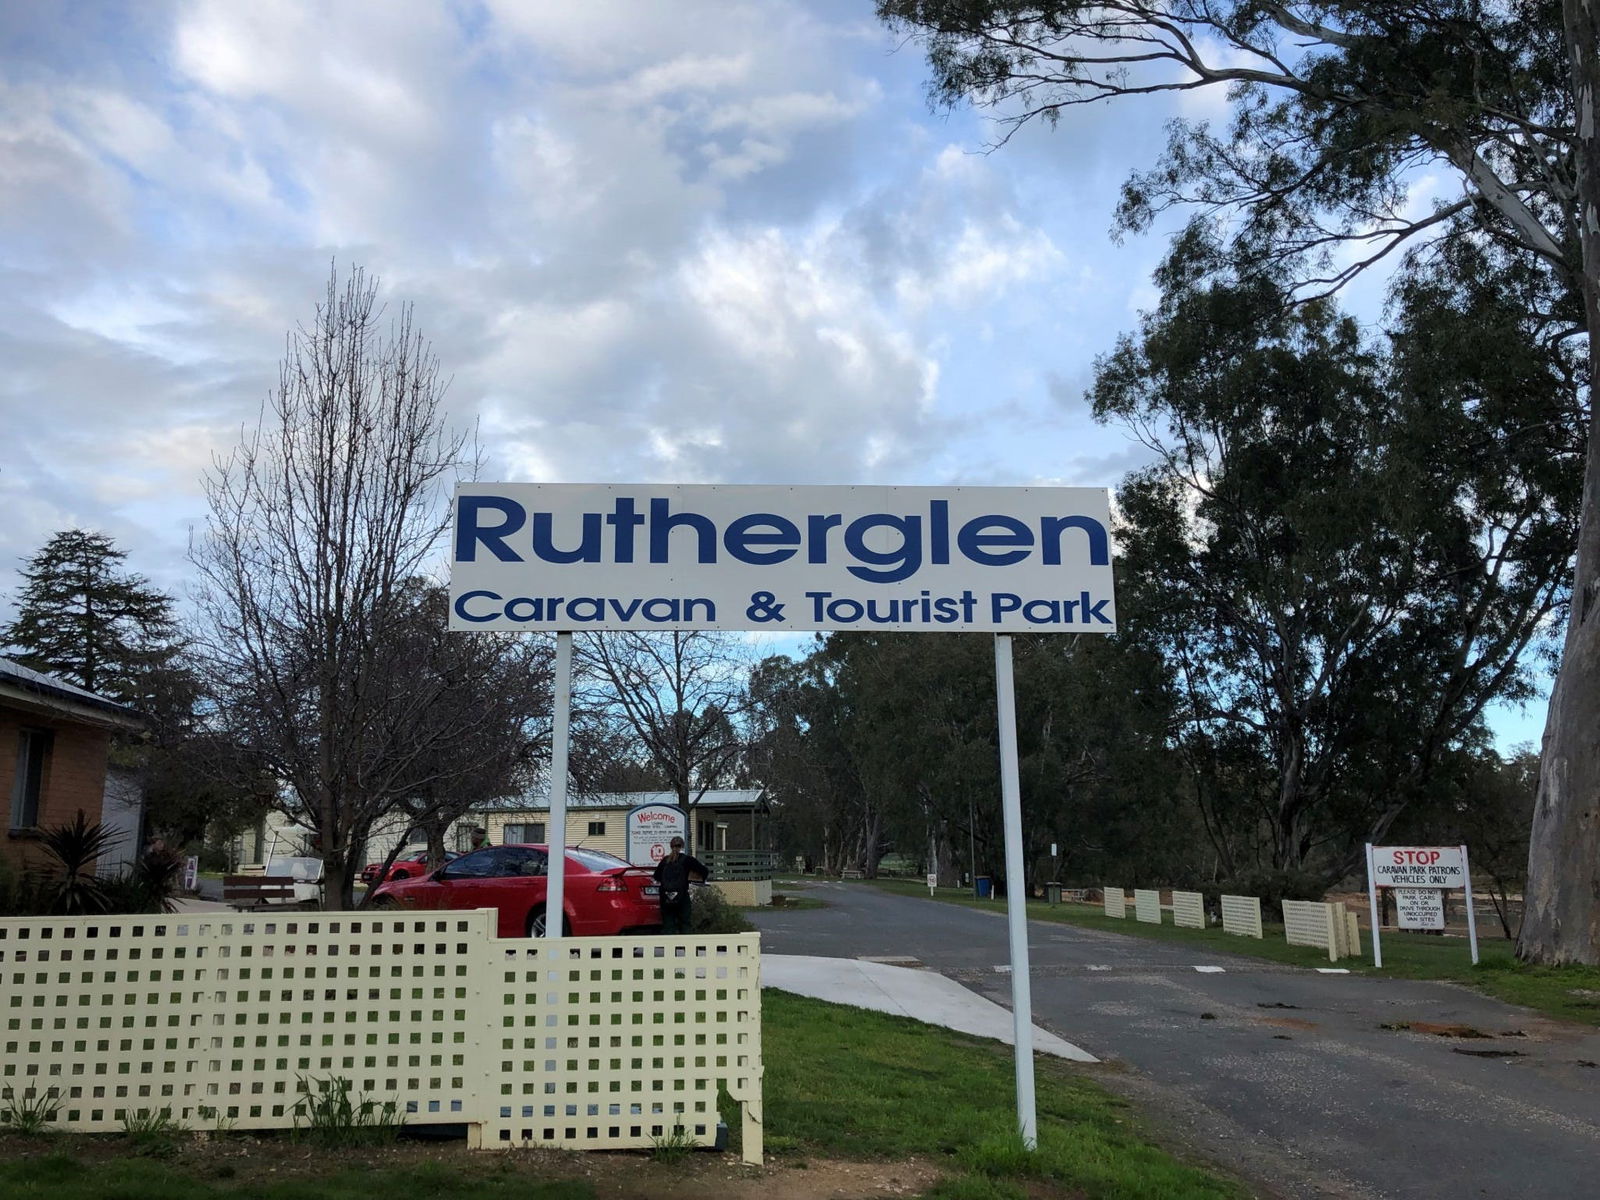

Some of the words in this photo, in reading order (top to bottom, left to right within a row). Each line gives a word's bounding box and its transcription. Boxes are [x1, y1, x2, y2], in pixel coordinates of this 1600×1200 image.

[455, 495, 1109, 584] Rutherglen
[454, 591, 716, 623] Caravan
[745, 592, 787, 623] &
[805, 591, 978, 624] Tourist
[991, 593, 1113, 626] Park
[637, 811, 676, 824] Welcome
[652, 845, 664, 856] 10
[1393, 851, 1441, 865] STOP
[1377, 866, 1408, 874] CARAVAN
[1409, 866, 1428, 875] PARK
[1428, 866, 1461, 875] PATRONS
[1391, 875, 1426, 884] VEHICLES
[1429, 876, 1448, 884] ONLY
